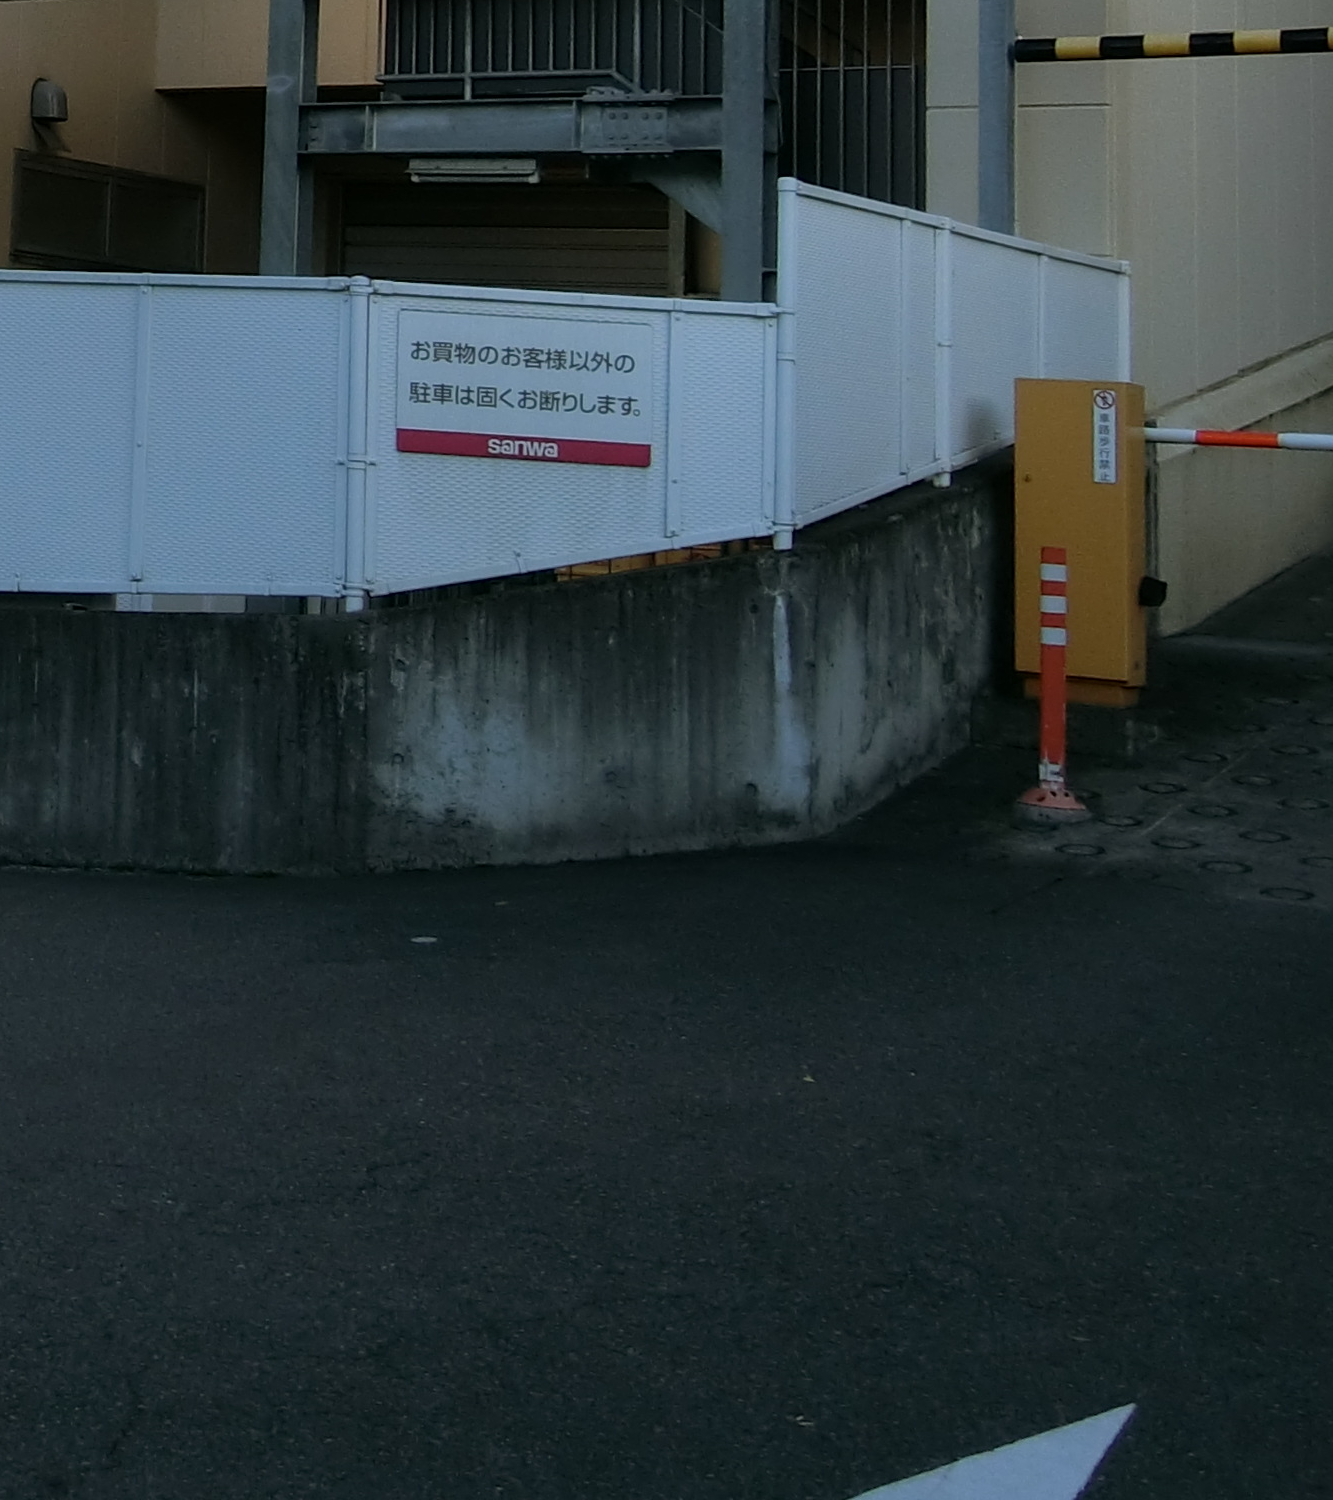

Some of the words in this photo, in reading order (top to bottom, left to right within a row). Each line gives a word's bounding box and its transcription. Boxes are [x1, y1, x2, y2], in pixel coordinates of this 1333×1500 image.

[410, 341, 636, 375] お買物のお客様以外の
[409, 381, 642, 418] 駐車は固くお断りします。
[488, 437, 559, 459] sanwa
